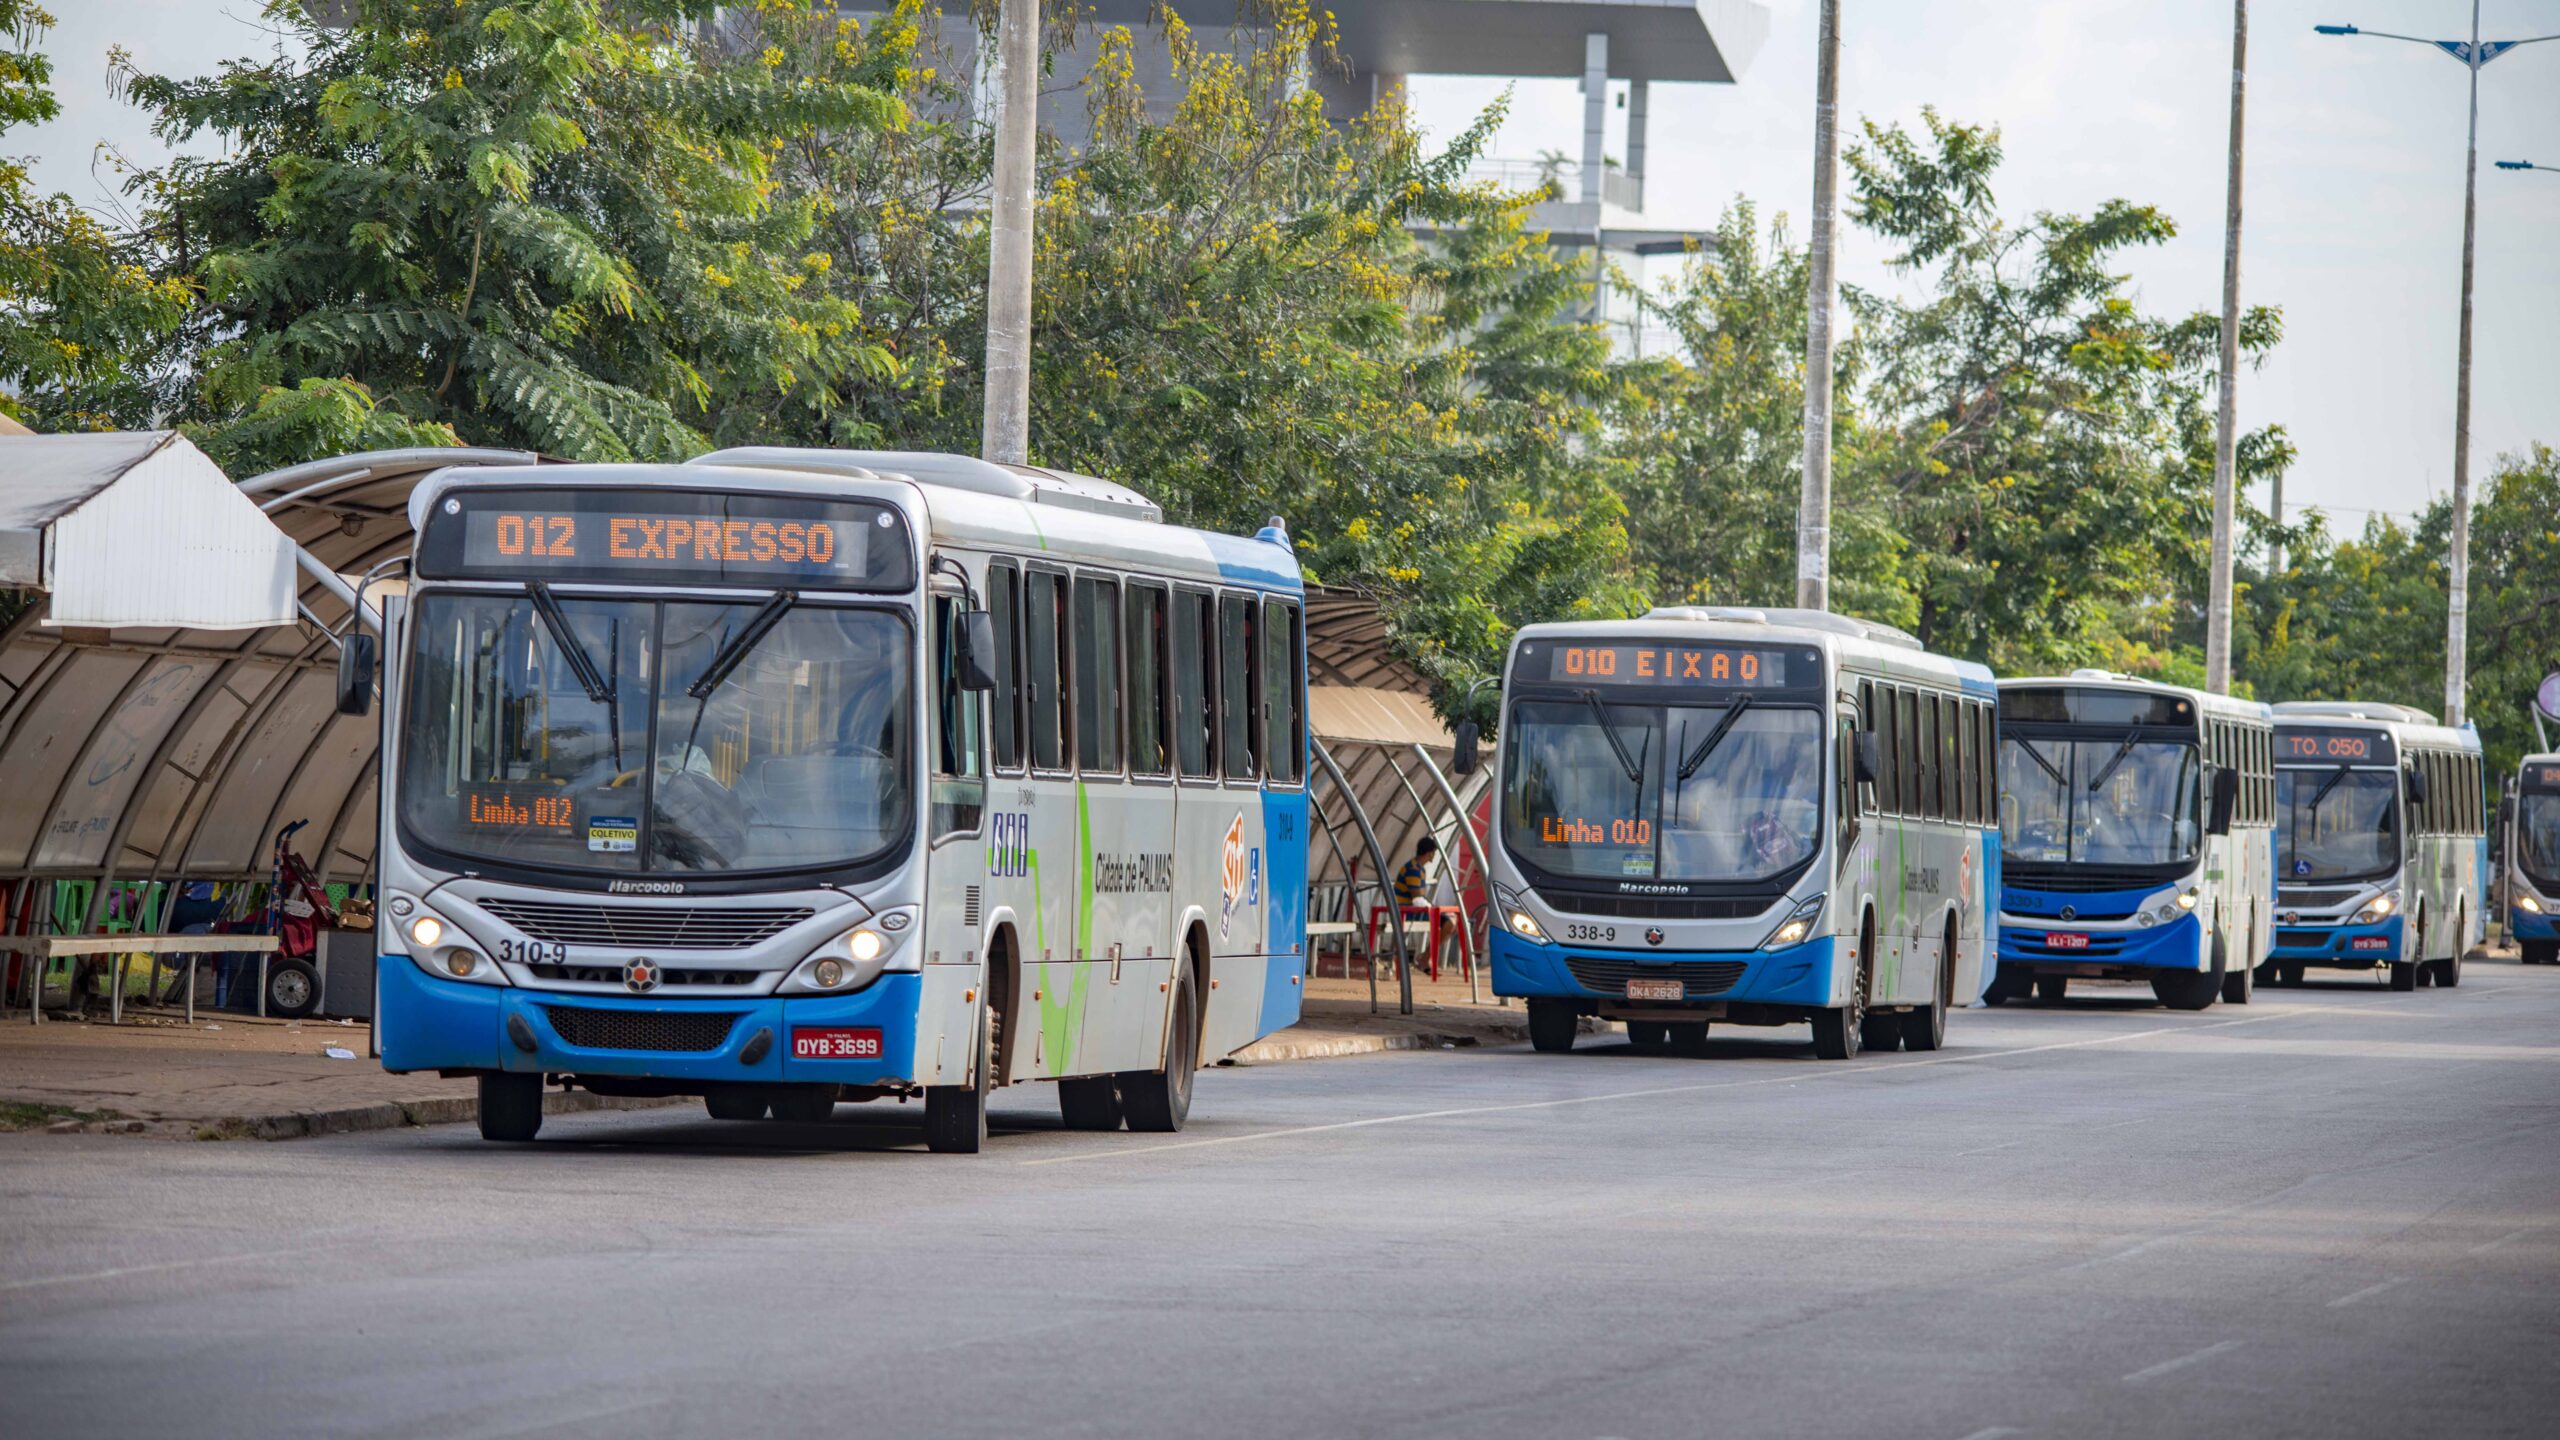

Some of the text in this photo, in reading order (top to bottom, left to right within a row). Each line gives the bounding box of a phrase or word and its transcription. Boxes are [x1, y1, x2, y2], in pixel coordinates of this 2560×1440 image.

[498, 515, 833, 563] 012 EXPRESSO
[1566, 648, 1616, 675] 010
[2327, 738, 2365, 756] 050
[471, 795, 572, 826] Linha 012
[591, 830, 634, 838] COLETIVO
[1542, 817, 1650, 844] Linha 010
[1095, 853, 1172, 892] Cidade de PALMAS
[1619, 882, 1689, 894] Marcopolo
[1567, 924, 1616, 941] 338-9
[499, 939, 566, 964] 310-9
